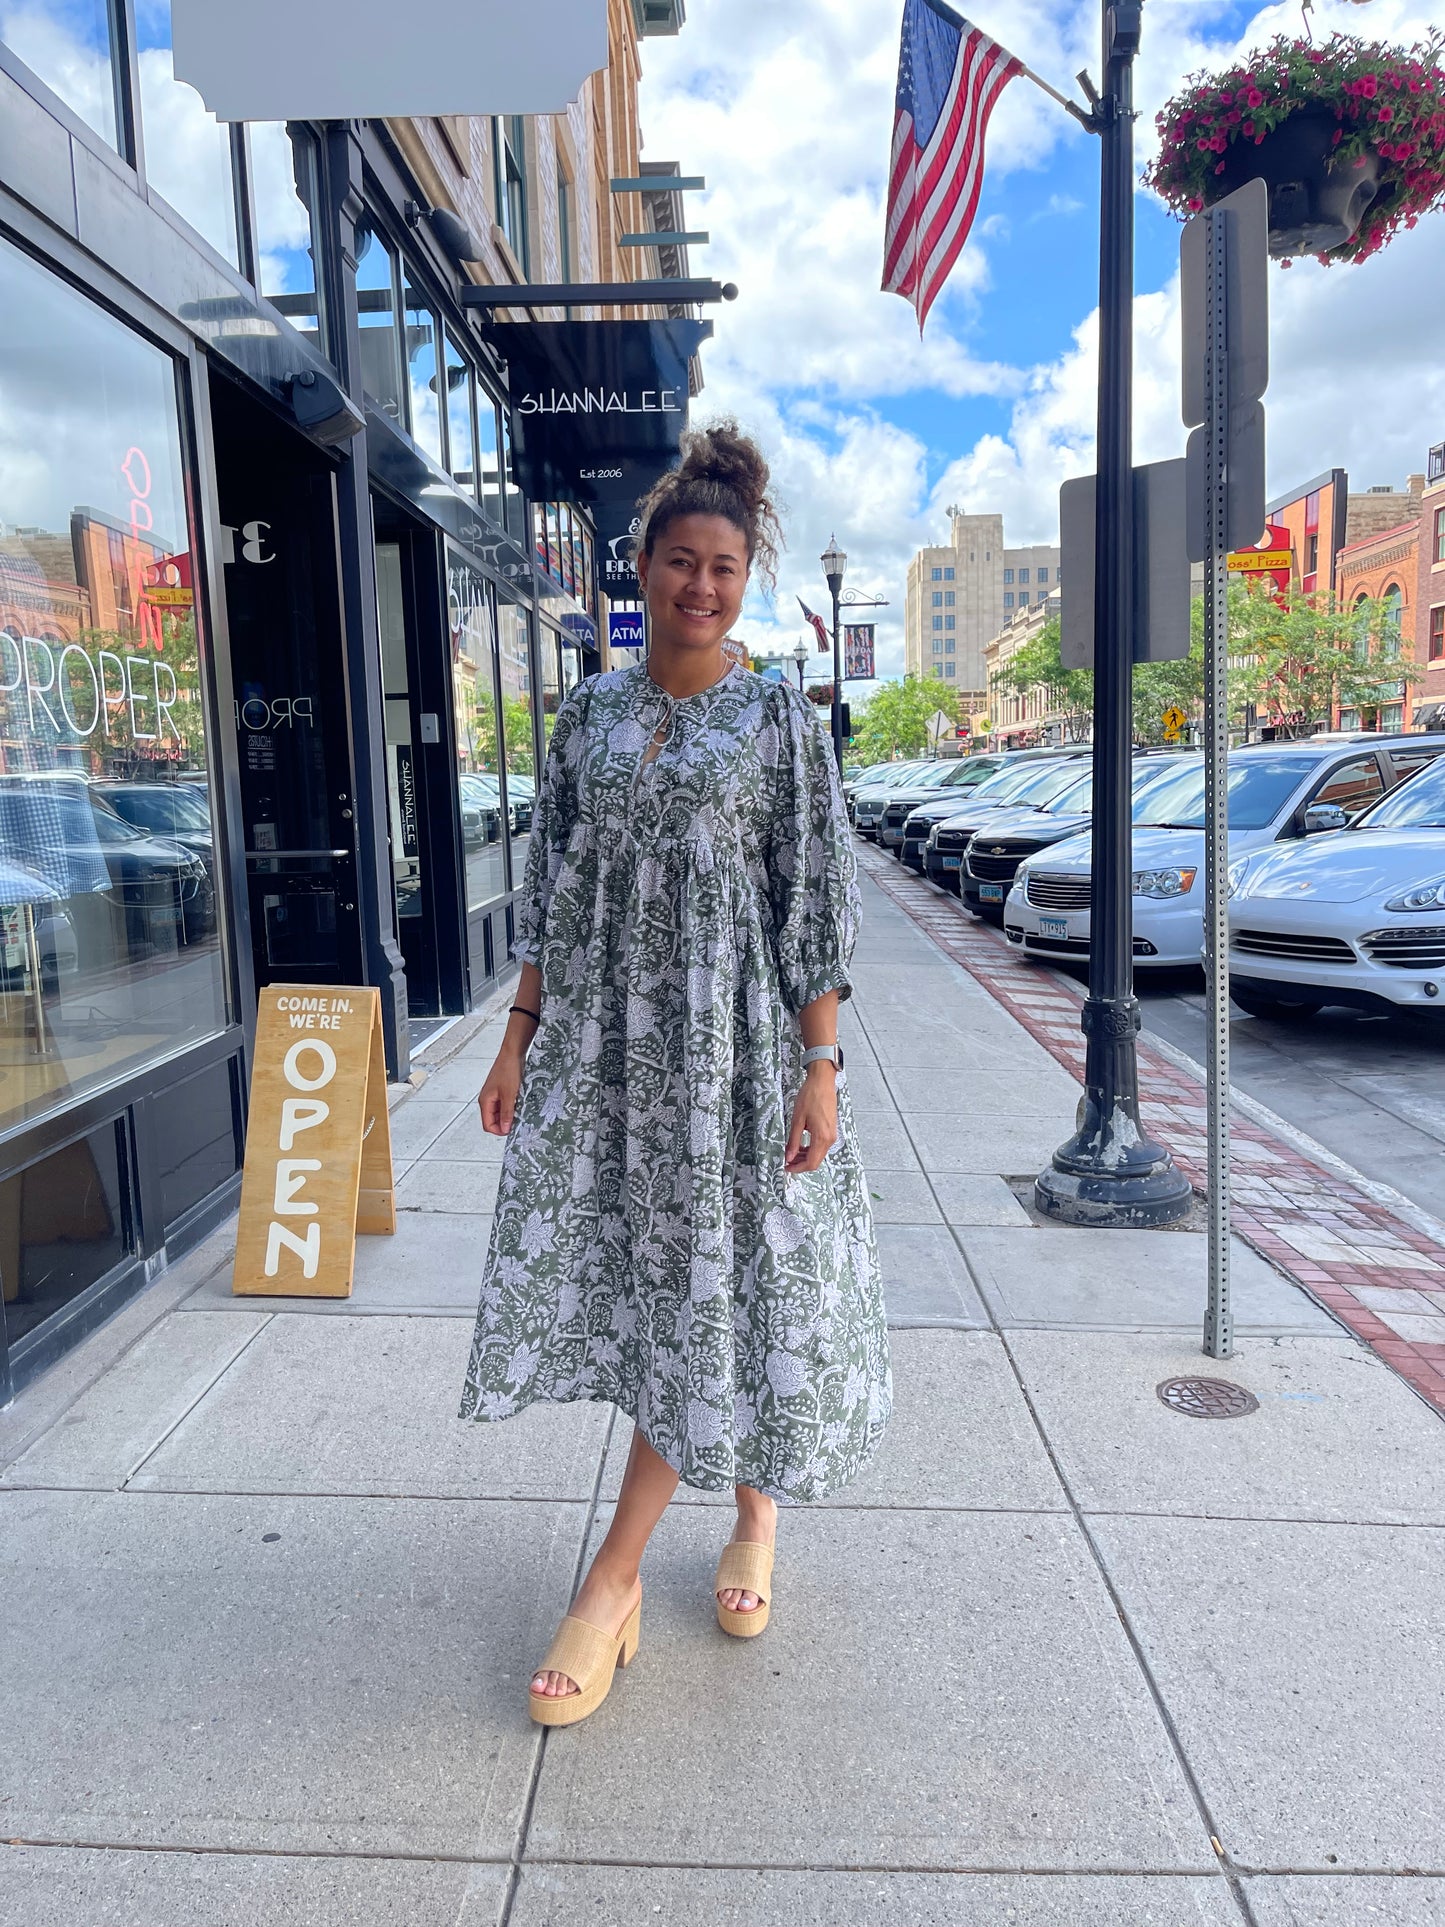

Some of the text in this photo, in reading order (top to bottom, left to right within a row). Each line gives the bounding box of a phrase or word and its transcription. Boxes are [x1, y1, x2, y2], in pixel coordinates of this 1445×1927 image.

[517, 387, 682, 414] SHANNALEE
[579, 468, 623, 479] Est 2006
[121, 447, 163, 651] OPEN
[1228, 555, 1288, 569] oss' Pizza
[611, 627, 643, 640] ATM
[401, 760, 416, 845] SHANNALEE
[277, 996, 354, 1015] COME IN,
[289, 1013, 342, 1031] WE'RE
[264, 1037, 338, 1280] OPEN
